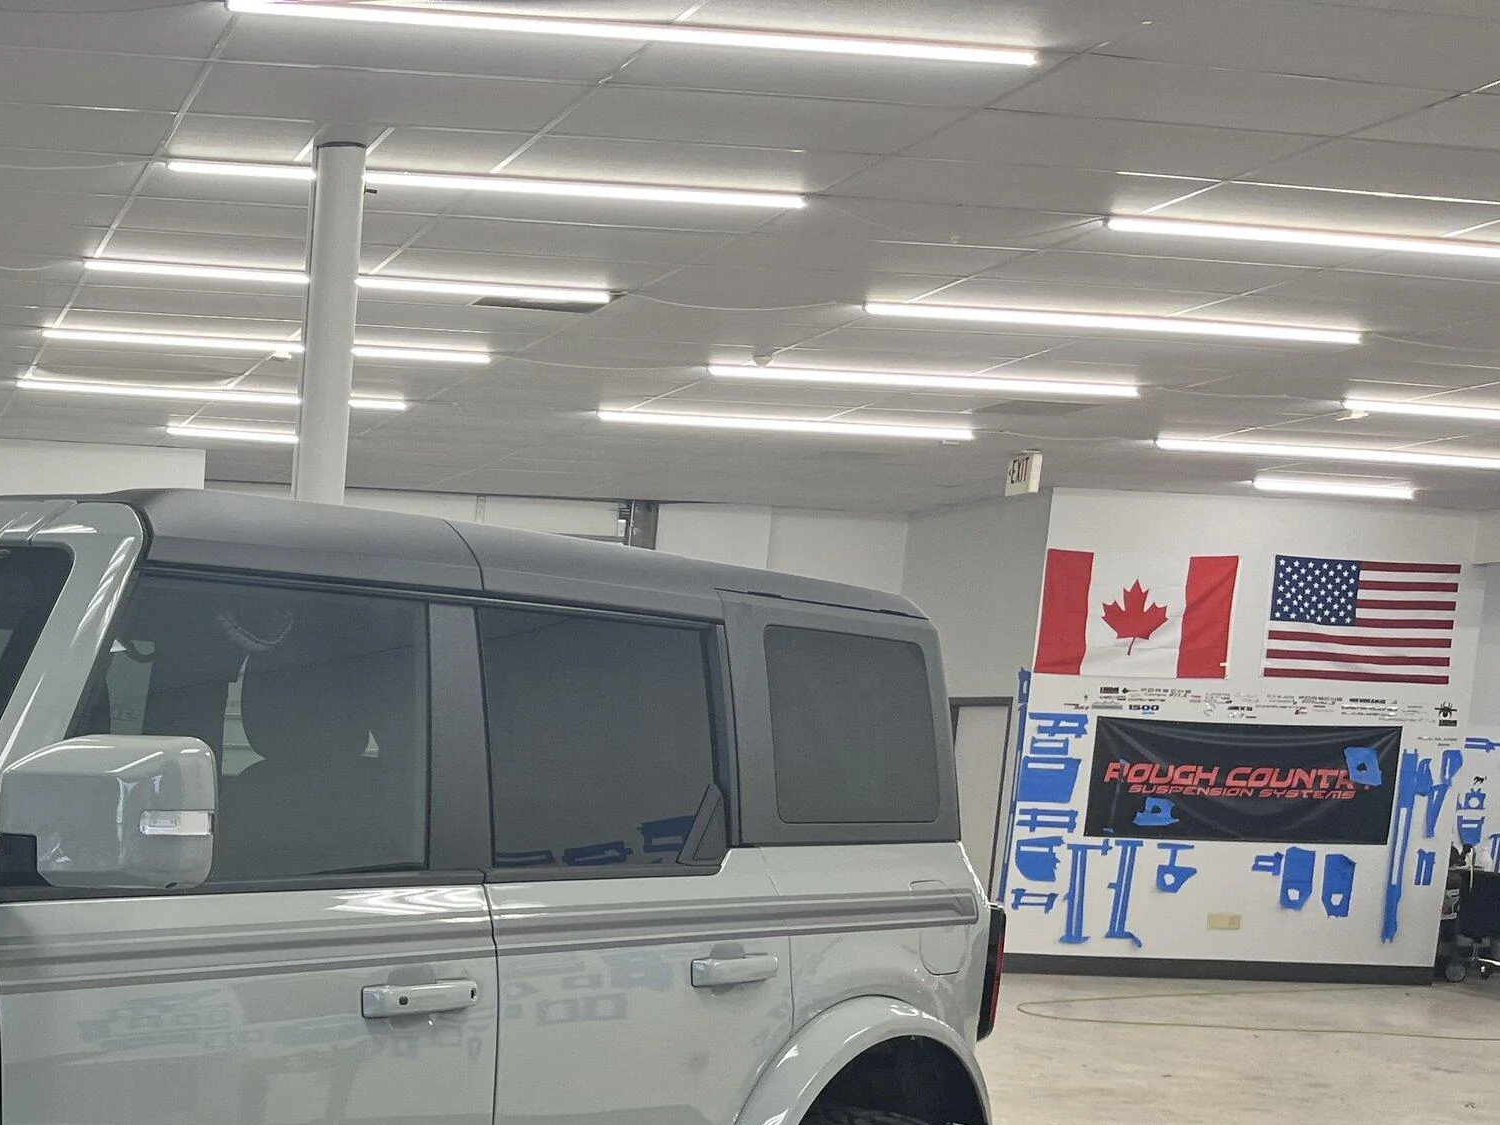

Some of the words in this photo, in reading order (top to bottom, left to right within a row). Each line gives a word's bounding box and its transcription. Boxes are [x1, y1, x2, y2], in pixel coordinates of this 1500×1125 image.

[1104, 762, 1218, 785] ROUGH
[1225, 766, 1370, 791] COUNTR
[1128, 784, 1252, 797] SUSPENSION
[1259, 788, 1357, 801] SYSTEMS
